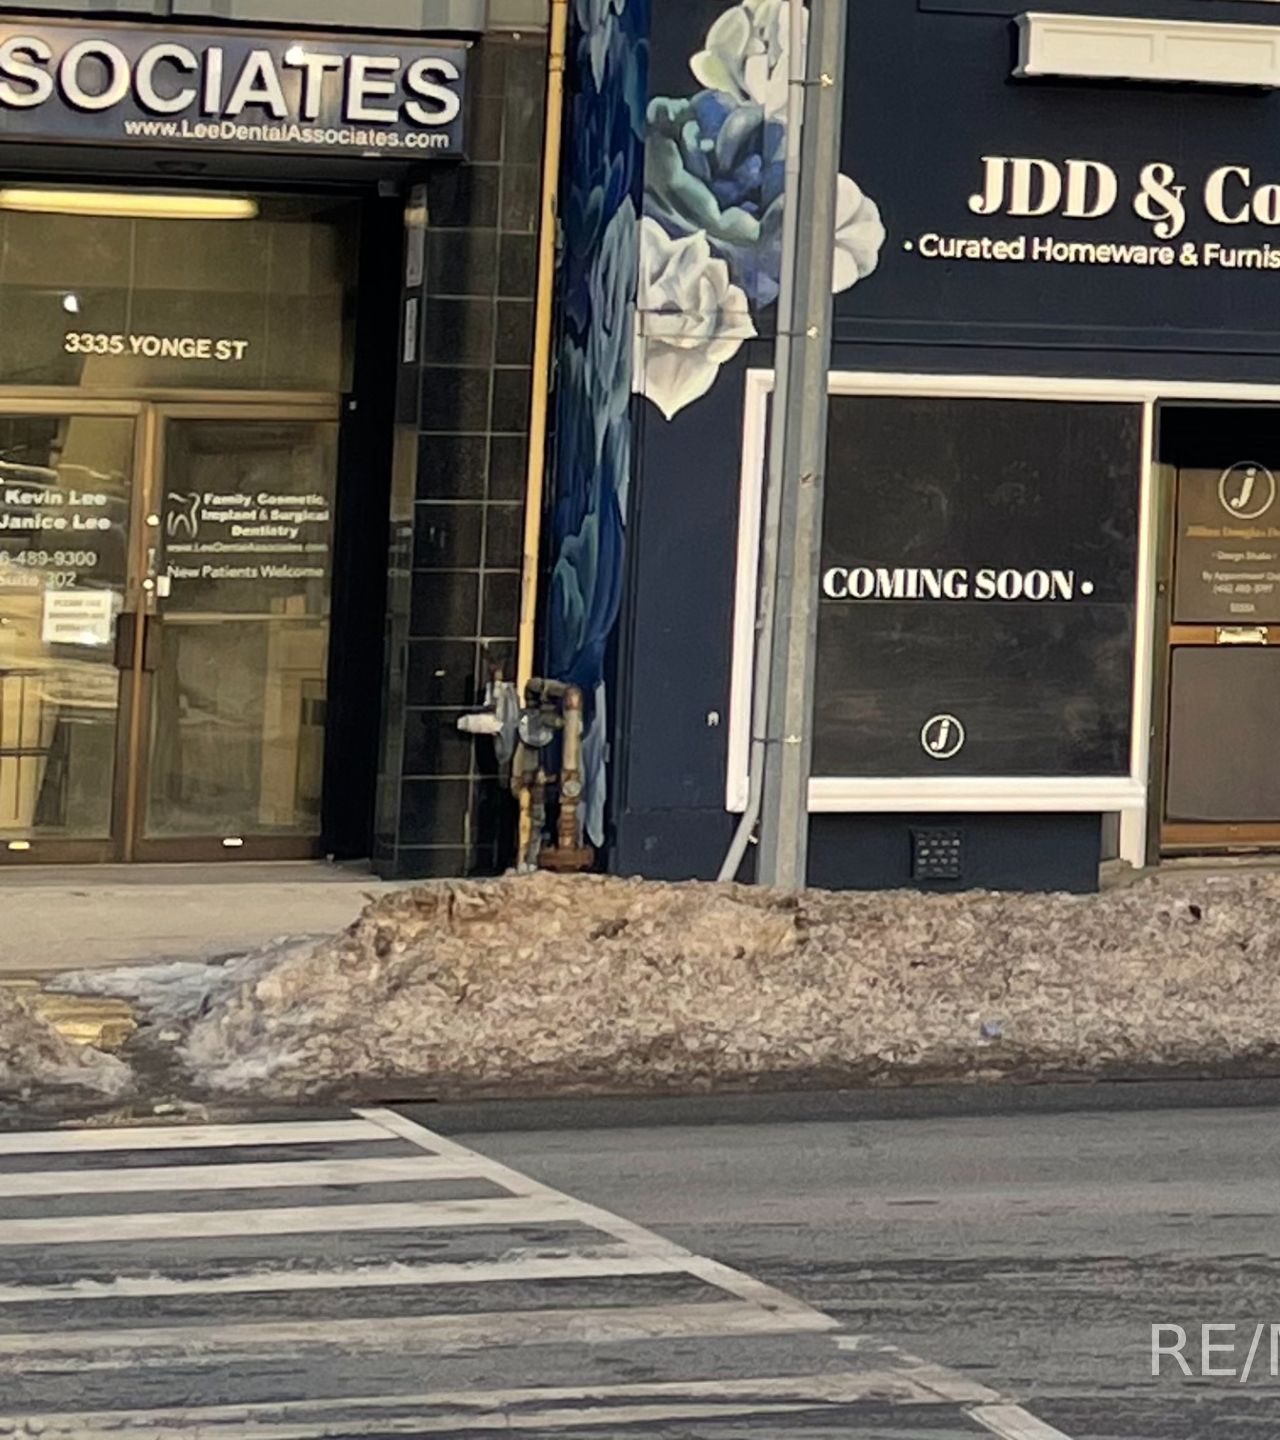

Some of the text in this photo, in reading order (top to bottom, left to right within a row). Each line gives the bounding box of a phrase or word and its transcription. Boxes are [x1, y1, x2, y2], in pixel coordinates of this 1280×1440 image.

[0, 36, 461, 126] SOCIATES
[125, 118, 449, 150] www.LeeDentalAssociates.com
[968, 156, 1118, 219] JDD
[1132, 162, 1186, 240] &
[918, 233, 1026, 261] Curated
[1032, 237, 1174, 266] Homeware
[1179, 242, 1198, 267] &
[64, 332, 248, 361] 3335 YONGE ST
[5, 489, 107, 506] Kevin Lee
[0, 513, 112, 530] Janice Lee
[231, 525, 299, 539] Dentistry
[167, 565, 324, 578] New Patients Welcome
[823, 568, 1074, 602] COMING SOON
